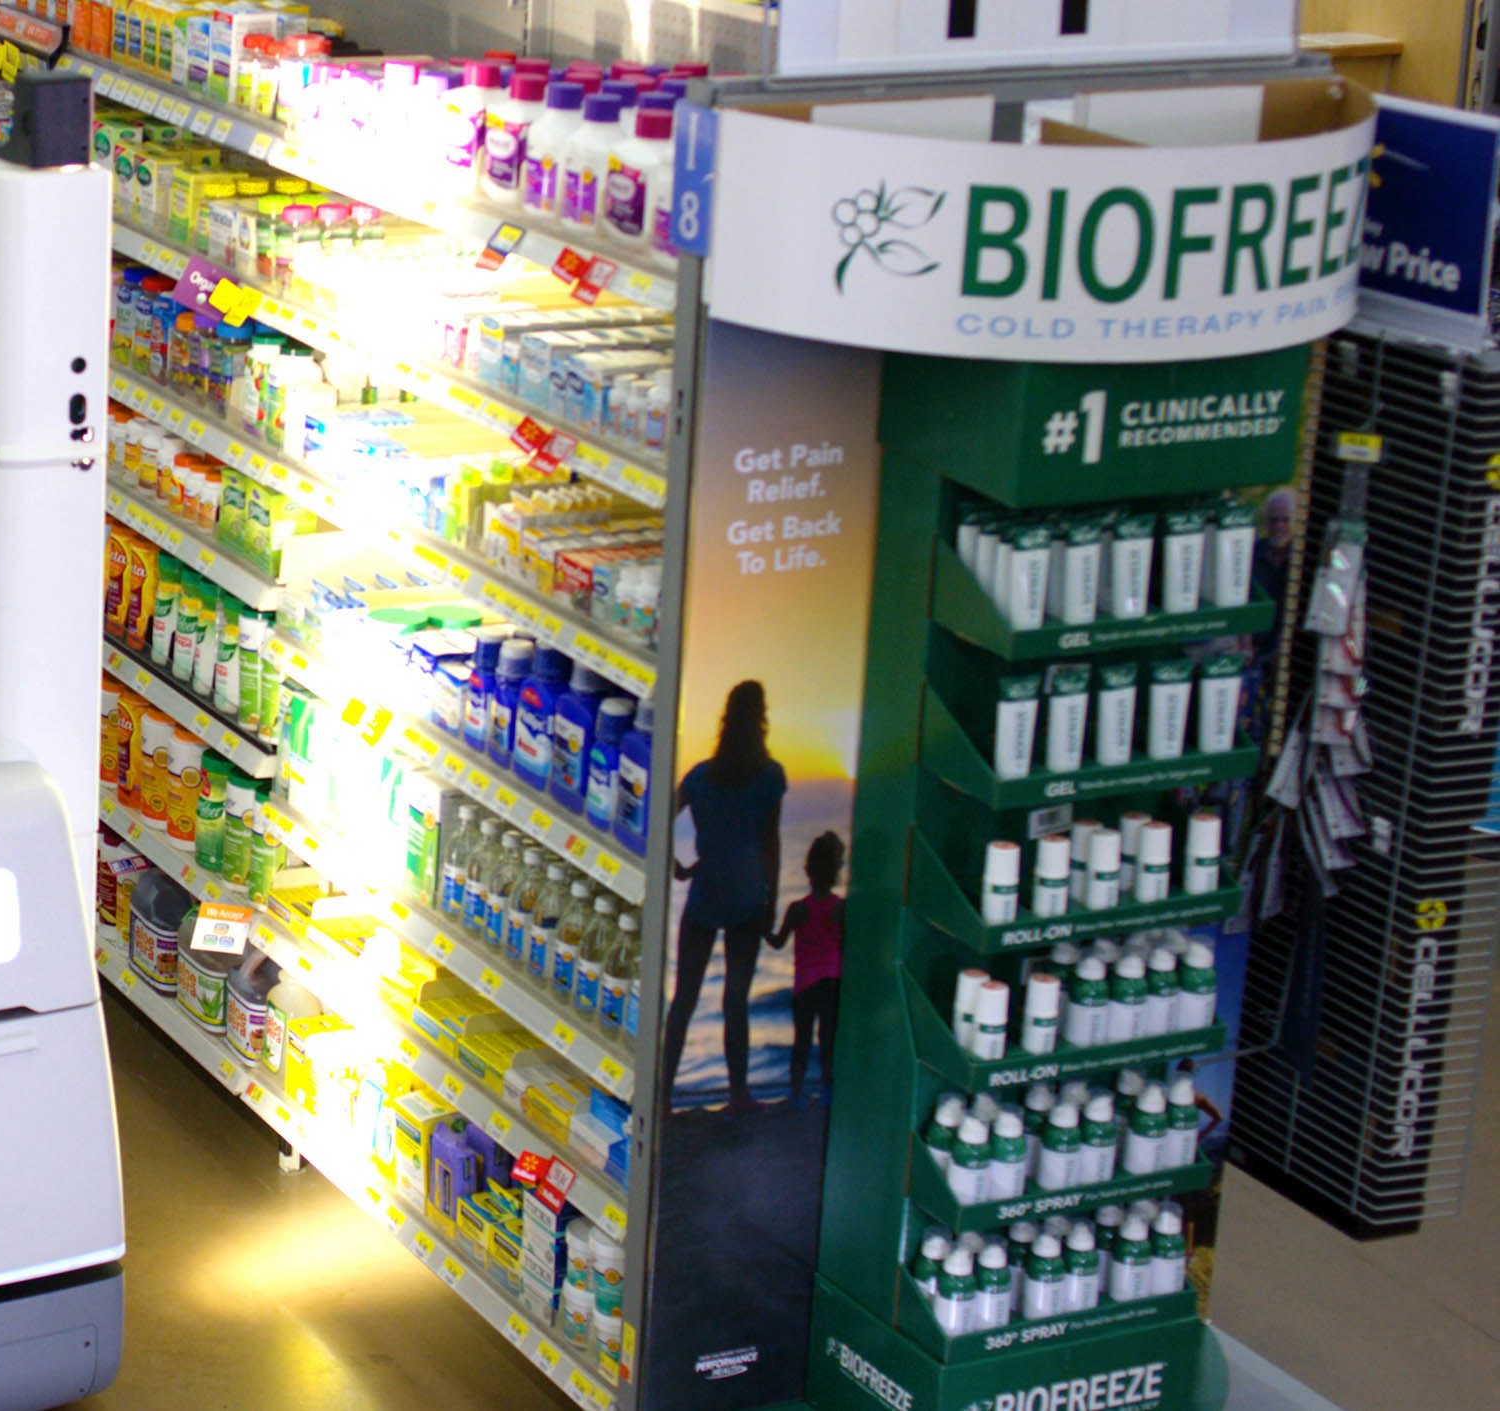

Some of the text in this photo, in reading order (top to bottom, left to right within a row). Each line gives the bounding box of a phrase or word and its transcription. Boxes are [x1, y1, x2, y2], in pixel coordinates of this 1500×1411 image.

[961, 157, 1370, 303] BIOFREEZ
[1387, 241, 1460, 291] Price
[955, 295, 1328, 340] COLD THERAPY PAIN
[1042, 389, 1284, 464] #1 CLINICALLY
[733, 440, 844, 475] Get Pain
[746, 473, 827, 503] Relief.
[726, 511, 842, 546] Get Back
[736, 543, 828, 575] To Life.
[1058, 631, 1092, 649] GEL
[1044, 780, 1077, 797] GEL
[1001, 922, 1074, 946] ROLL-ON
[1391, 937, 1439, 1158] CELLUCOR
[988, 1063, 1059, 1088] ROLL-ON
[1034, 1192, 1084, 1215] SPRAY
[1018, 1321, 1070, 1344] SPRAY
[694, 1351, 759, 1373] PERFORMANCE
[838, 1343, 915, 1411] BIOFREEZE
